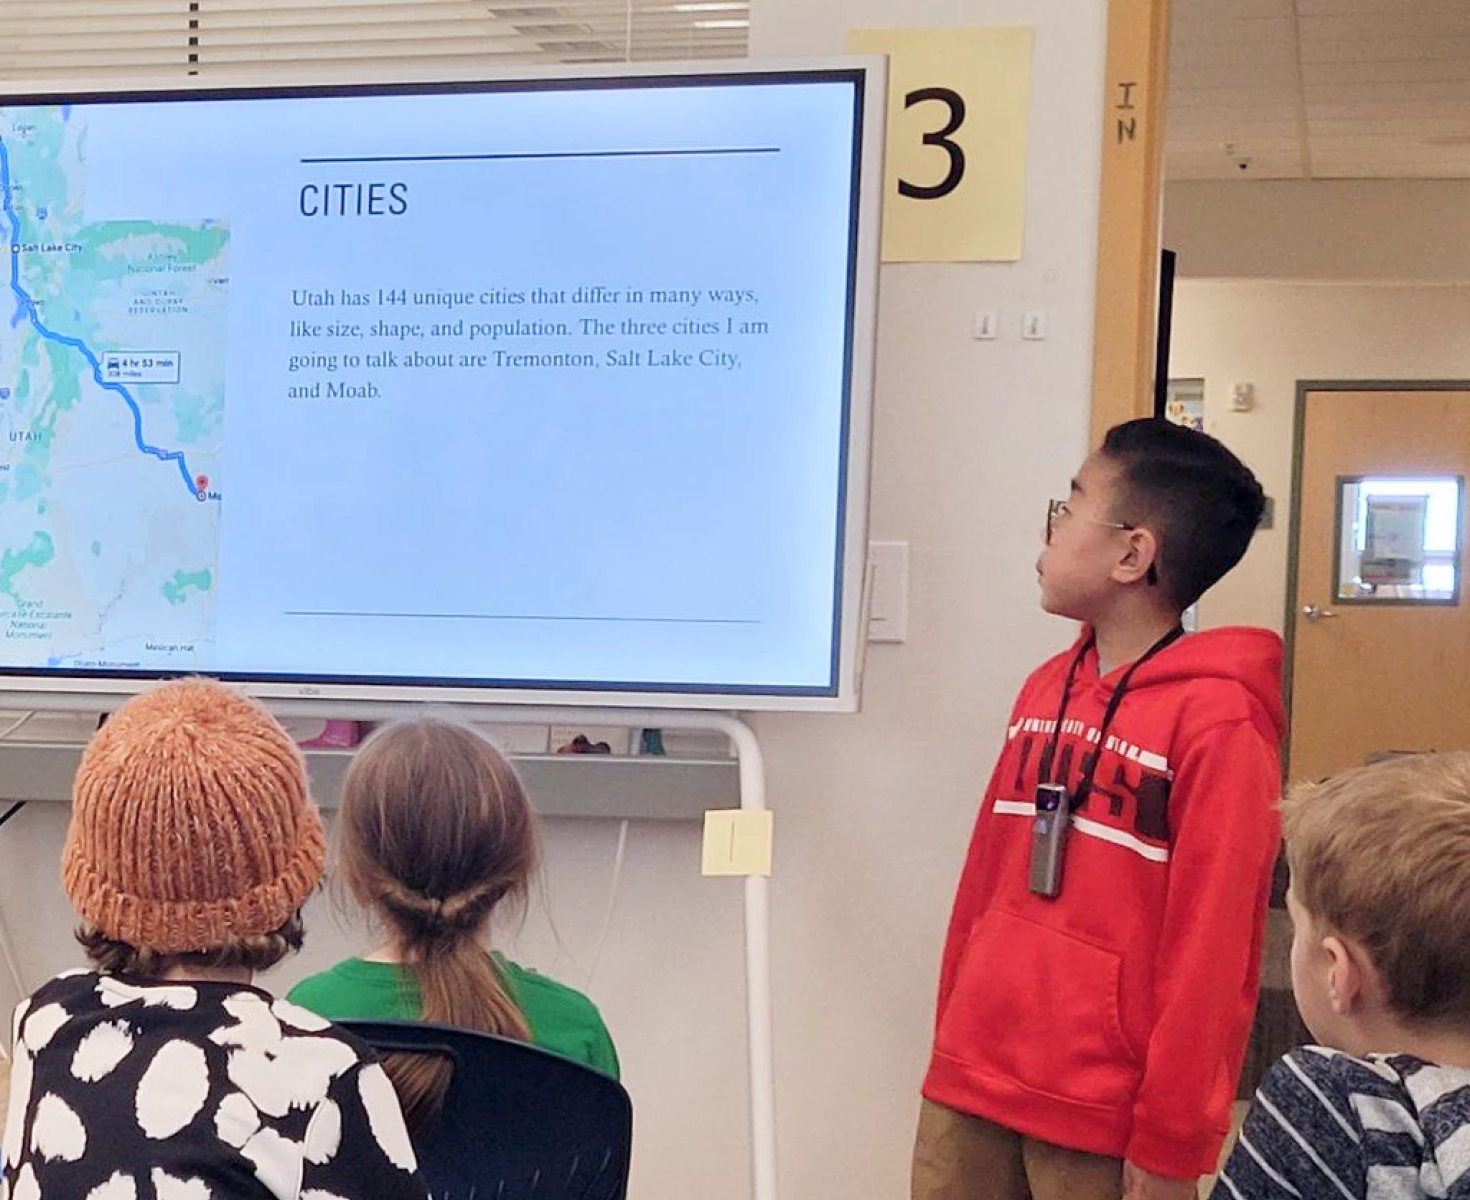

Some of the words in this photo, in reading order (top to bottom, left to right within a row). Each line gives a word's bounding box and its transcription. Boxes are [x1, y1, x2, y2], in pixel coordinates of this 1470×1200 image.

[1113, 81, 1138, 145] IN
[896, 86, 967, 200] 3
[299, 181, 409, 217] CITIES
[21, 242, 39, 253] Salt
[41, 242, 64, 253] Lake
[65, 242, 83, 253] City
[292, 289, 335, 307] Utah
[340, 288, 370, 307] has
[378, 288, 407, 306] 144
[413, 288, 475, 308] unique
[479, 286, 526, 305] cities
[530, 286, 566, 305] that
[571, 285, 621, 304] differ
[625, 285, 643, 304] in
[649, 290, 703, 306] many
[708, 289, 759, 306] ways,
[290, 319, 322, 338] like
[326, 320, 364, 339] size,
[369, 319, 425, 341] shape,
[430, 319, 464, 337] and
[468, 318, 573, 340] population.
[579, 318, 616, 336] The
[620, 317, 667, 336] three
[672, 317, 720, 335] cities
[726, 316, 733, 335] I
[738, 321, 769, 335] am
[156, 358, 174, 367] min
[288, 350, 338, 372] going
[343, 354, 361, 368] to
[365, 350, 399, 368] talk
[402, 350, 454, 368] about
[458, 354, 488, 368] are
[492, 350, 600, 368] Tremonton,
[605, 349, 641, 367] Salt
[647, 348, 694, 367] Lake
[698, 348, 742, 371] City,
[287, 381, 321, 399] and
[326, 381, 381, 399] Moab.
[9, 430, 43, 442] UTAH
